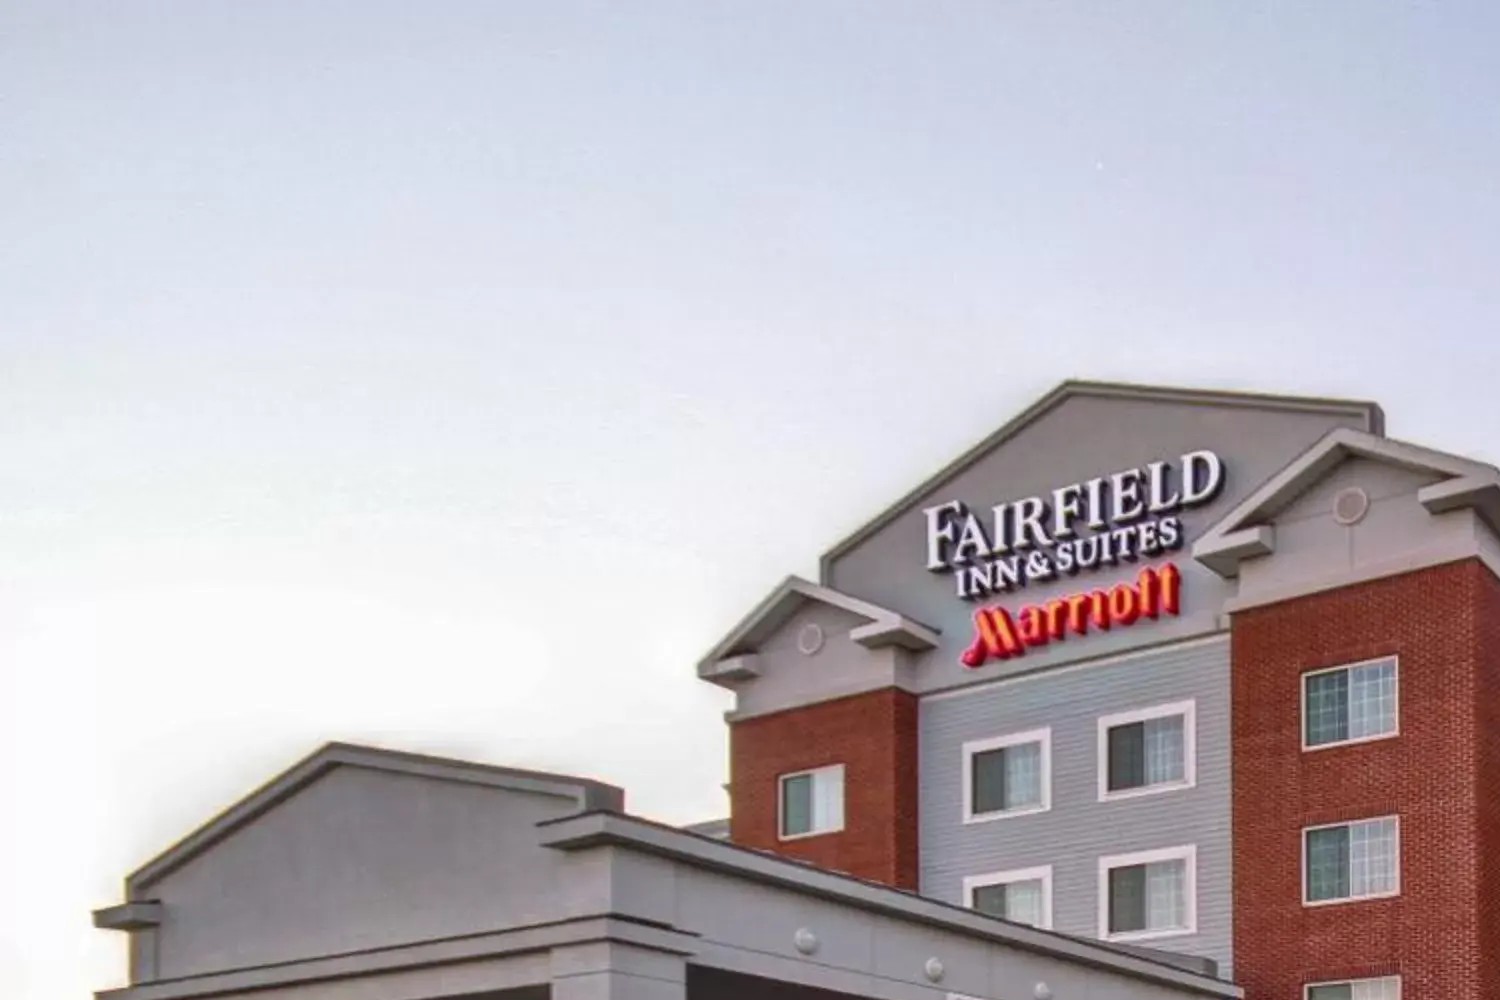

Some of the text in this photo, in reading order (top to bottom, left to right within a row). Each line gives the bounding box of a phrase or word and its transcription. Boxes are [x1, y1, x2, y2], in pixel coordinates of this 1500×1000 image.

[922, 449, 1224, 571] FAIRFIELD
[955, 515, 1180, 598] INN & SUITES
[960, 561, 1182, 668] Marriott
